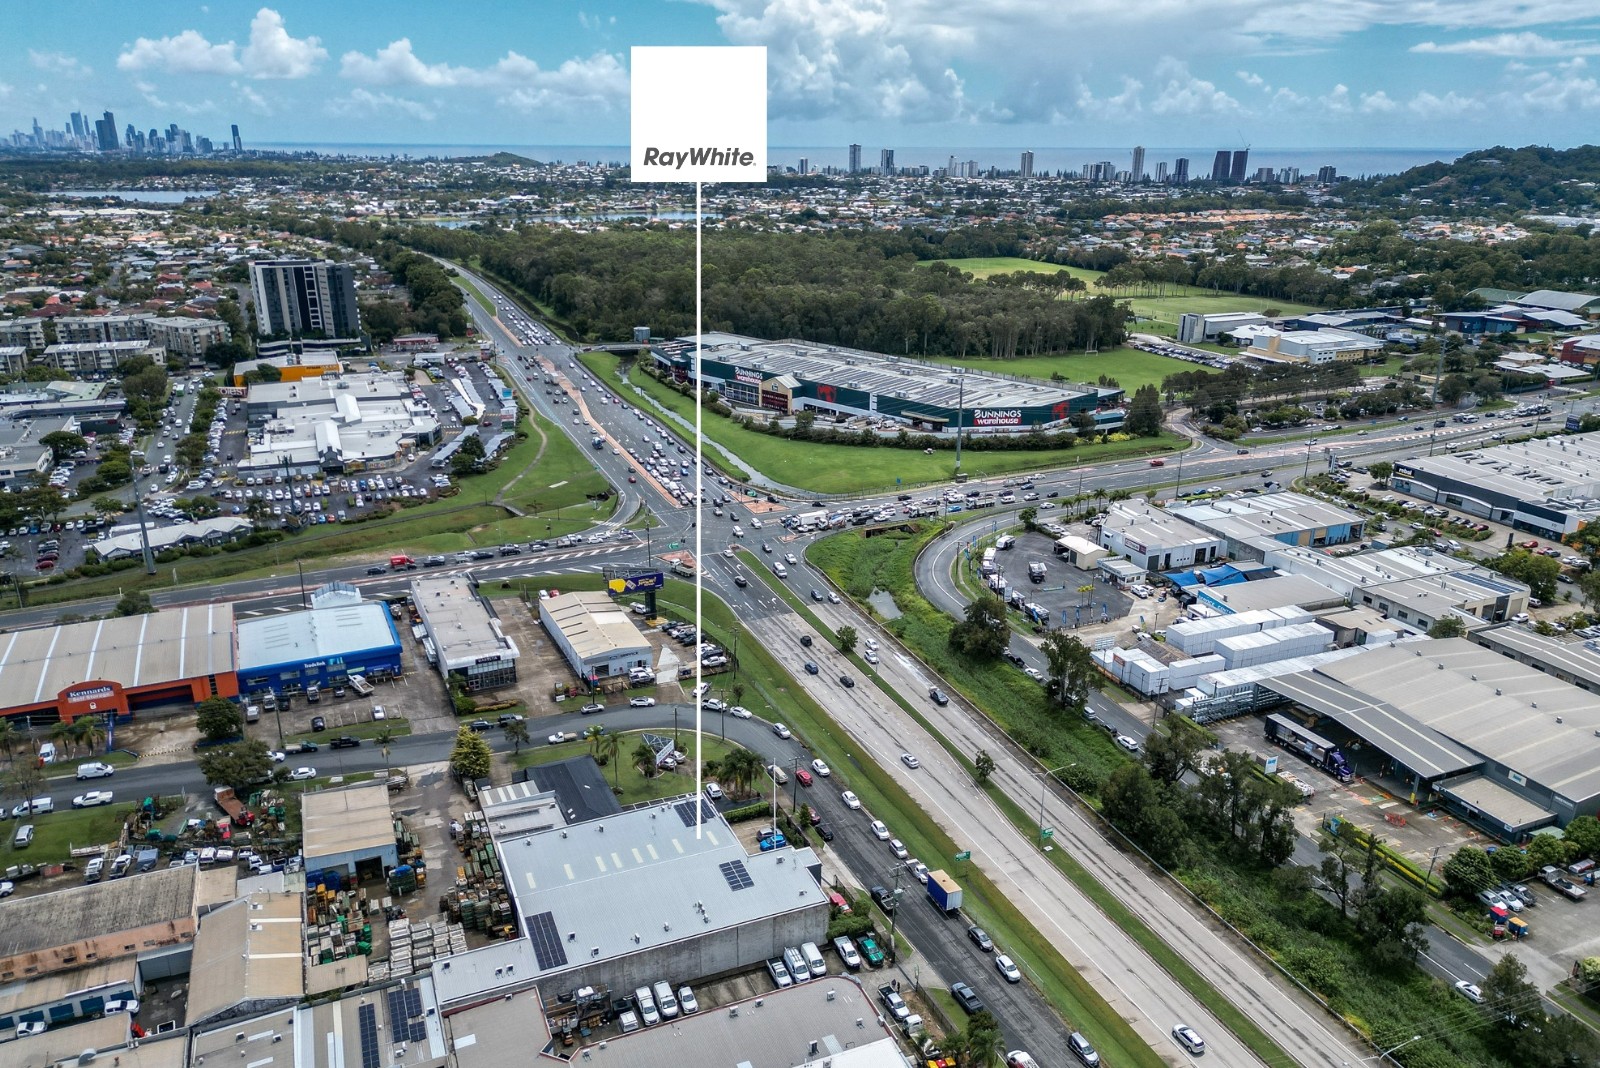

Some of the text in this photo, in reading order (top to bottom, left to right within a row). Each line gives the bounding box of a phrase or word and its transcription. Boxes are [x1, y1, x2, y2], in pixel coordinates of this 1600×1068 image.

[735, 366, 763, 380] BUNNINGS
[974, 410, 1022, 418] BUNNINGS
[976, 417, 1019, 425] warehouse
[69, 686, 112, 698] Kennards
